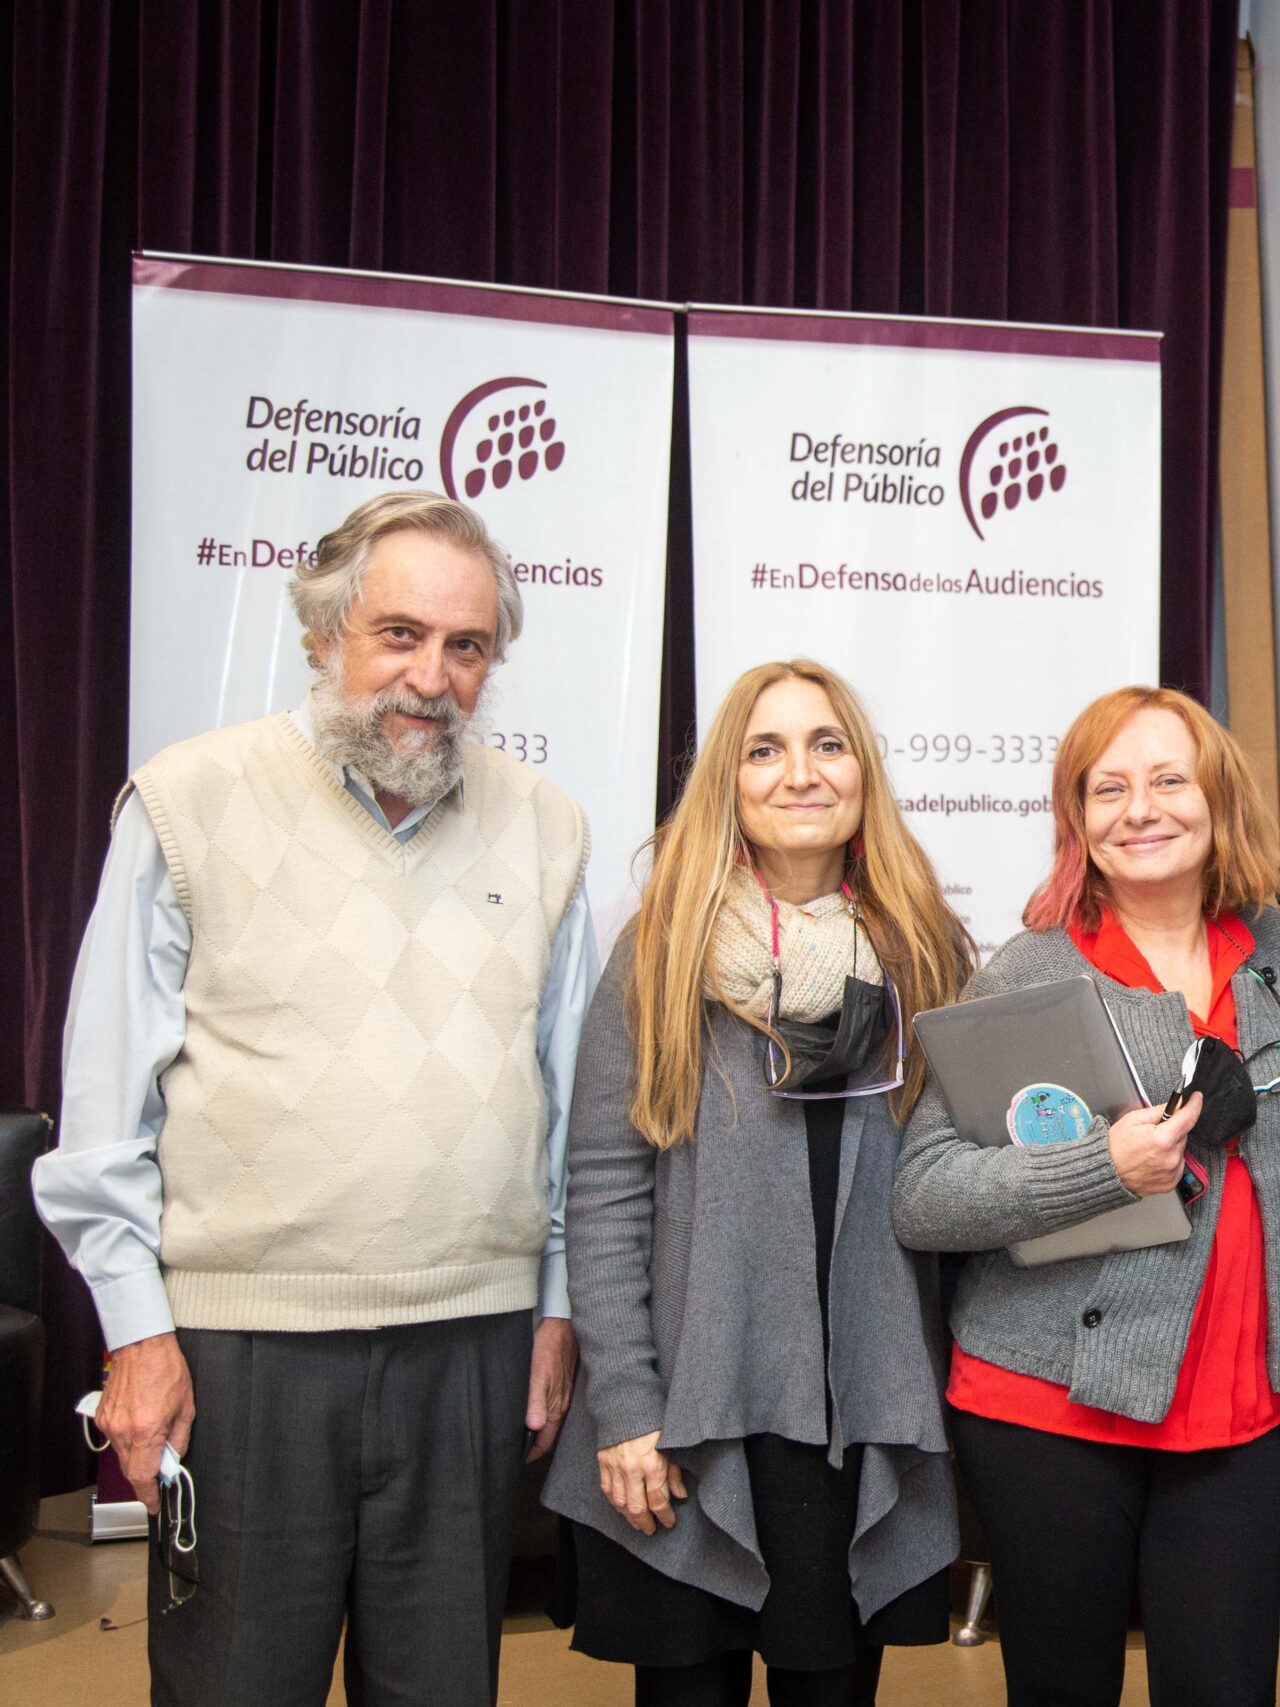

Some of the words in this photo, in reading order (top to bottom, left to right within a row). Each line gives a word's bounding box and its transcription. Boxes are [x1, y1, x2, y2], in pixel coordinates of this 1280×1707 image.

[246, 396, 421, 440] Defensoría
[246, 438, 298, 473] del
[306, 442, 424, 481] Público
[790, 432, 941, 468] Defensoría
[791, 471, 834, 501] del
[843, 473, 945, 506] Público
[506, 554, 604, 588] encias
